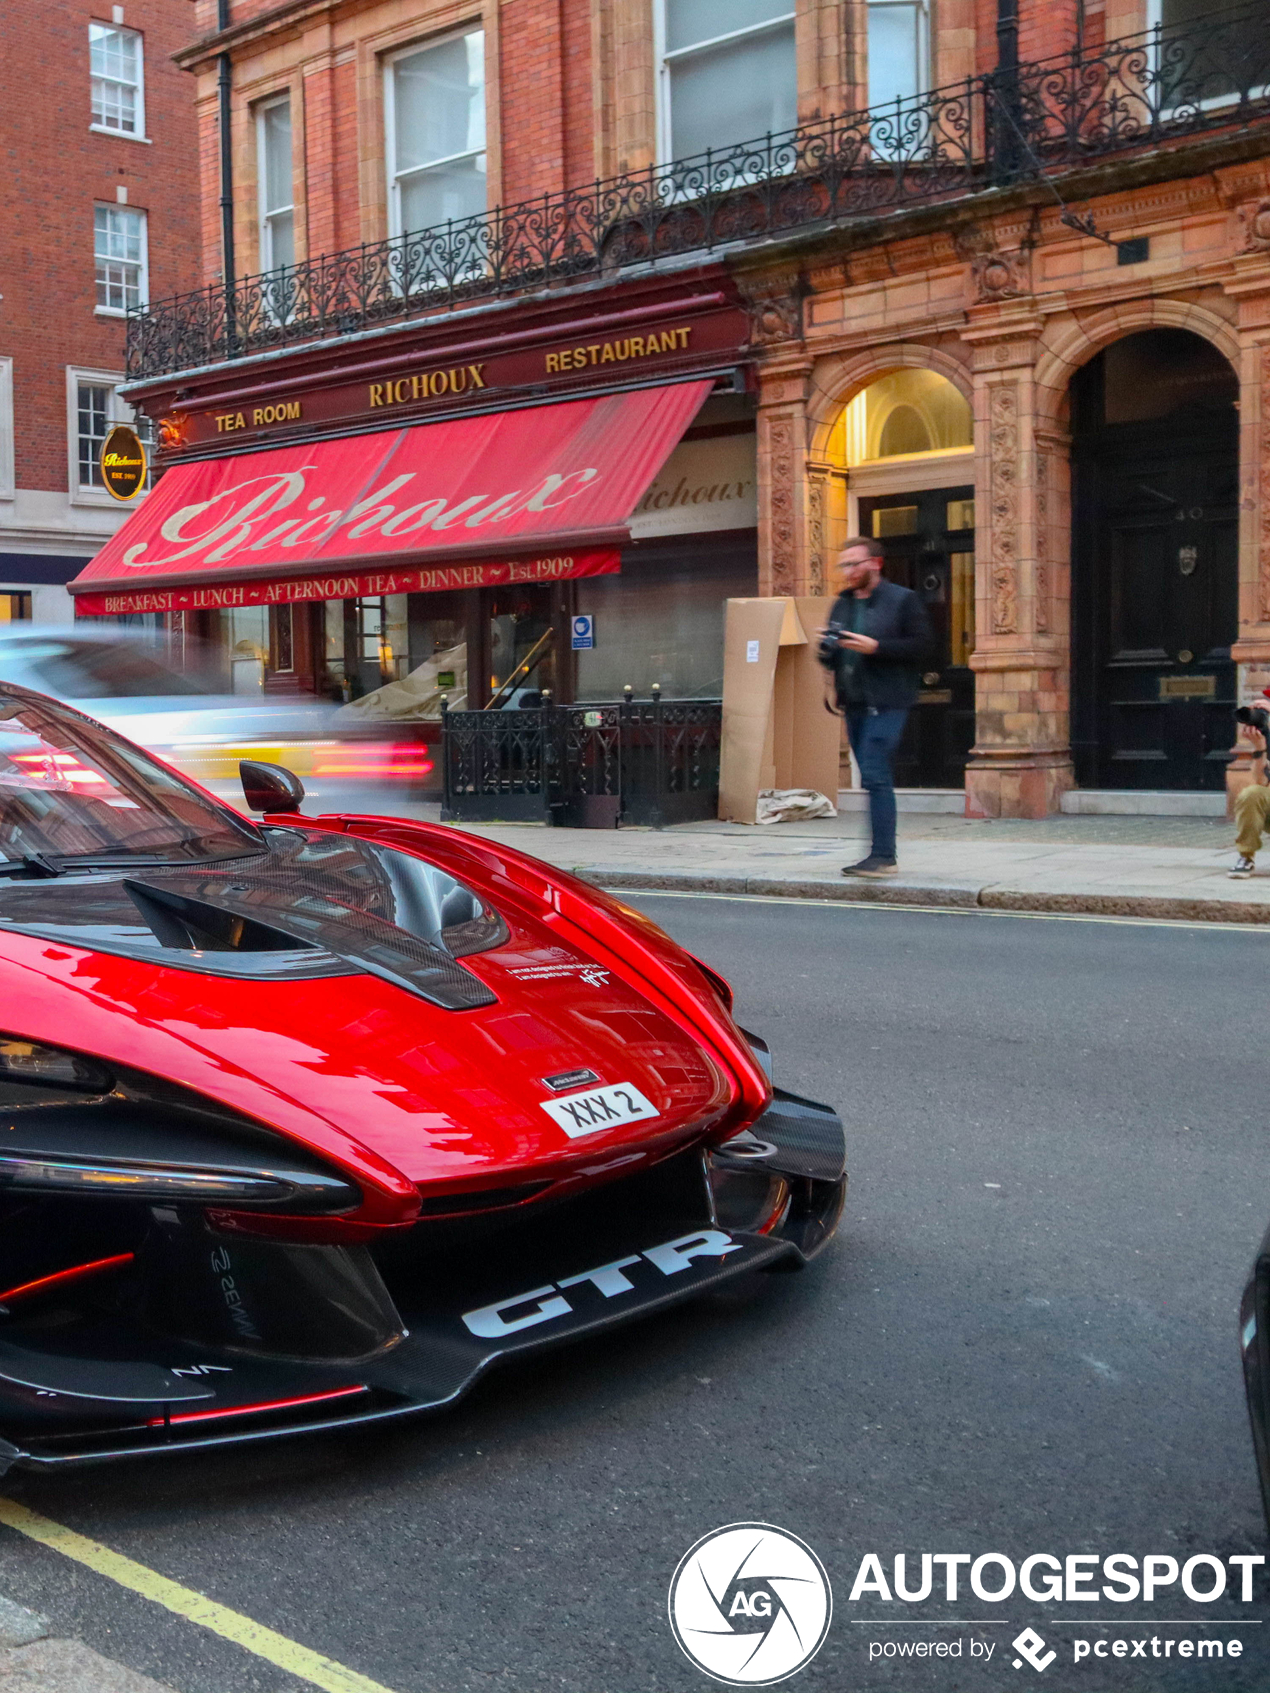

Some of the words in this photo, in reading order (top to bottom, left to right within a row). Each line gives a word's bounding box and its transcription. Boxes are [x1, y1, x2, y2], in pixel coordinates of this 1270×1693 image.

[215, 414, 245, 432] TEA
[253, 401, 301, 427] ROOM
[369, 363, 486, 408] RICHOUX
[545, 327, 691, 374] RESTAURANT
[104, 453, 143, 466] Richoux
[123, 465, 603, 568] Richoux
[633, 477, 750, 511] ichoux
[105, 592, 174, 613] BREAKFAST
[193, 587, 244, 607] LUNCH
[265, 577, 358, 602] AFTERNOON
[367, 574, 397, 594] TEA
[420, 565, 484, 589] DINNER
[559, 1095, 622, 1128] XXX
[613, 1090, 644, 1114] 2
[461, 1229, 744, 1338] GTR
